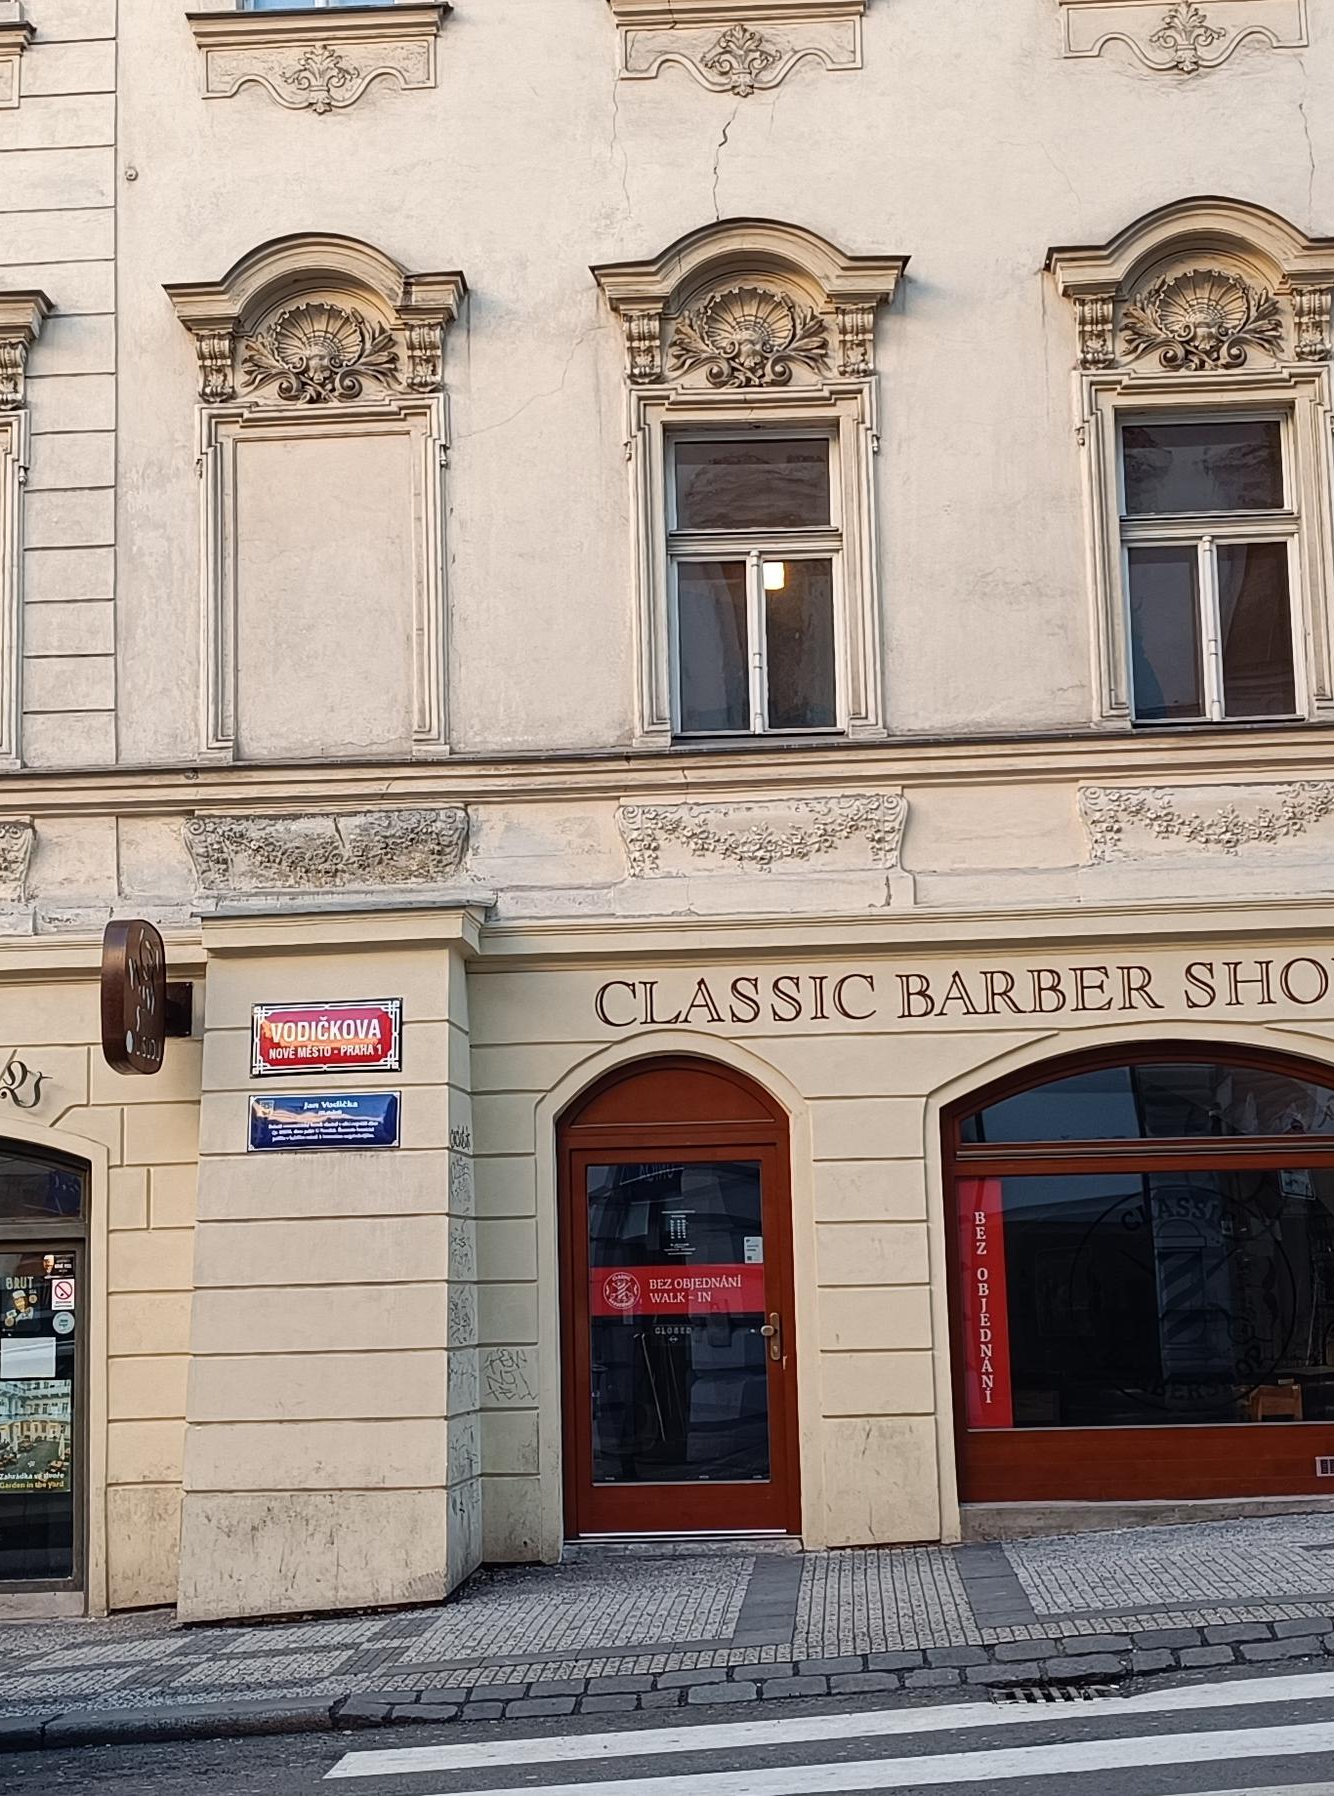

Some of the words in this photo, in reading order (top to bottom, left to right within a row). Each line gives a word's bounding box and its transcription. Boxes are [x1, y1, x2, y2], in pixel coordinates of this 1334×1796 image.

[594, 972, 877, 1027] CLASSIC
[896, 964, 1165, 1020] BARBER
[271, 1016, 382, 1043] VODIČKOVA
[269, 1046, 295, 1060] NOVÉ
[298, 1045, 332, 1058] MĚSTO
[340, 1045, 373, 1057] PRAHA
[376, 1044, 382, 1055] 1
[974, 1211, 987, 1255] BEZ
[5, 1276, 34, 1290] BRUT
[649, 1279, 673, 1290] BEZ
[674, 1274, 742, 1291] OBJEDNÁNÍ
[649, 1292, 686, 1303] WALK
[698, 1292, 712, 1303] IN
[977, 1267, 994, 1404] OBJEDNÁNÍ
[0, 1481, 26, 1489] Garden
